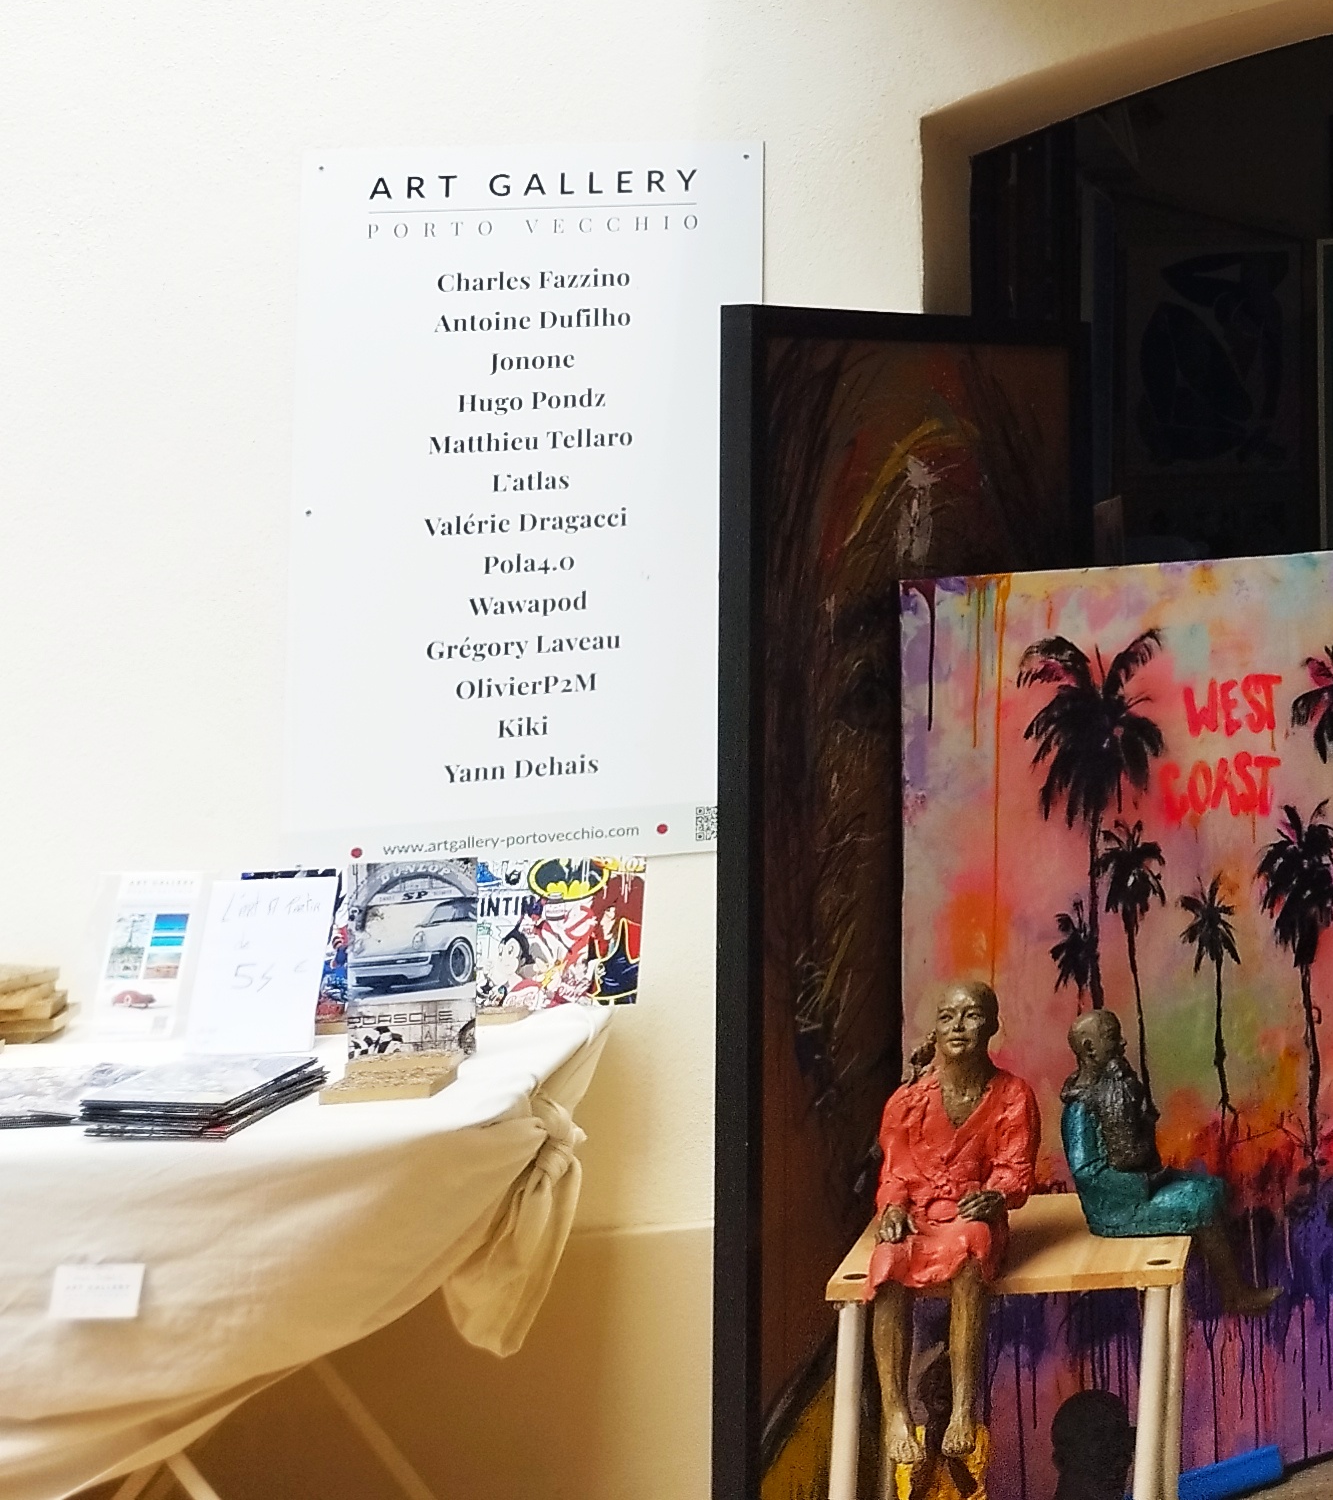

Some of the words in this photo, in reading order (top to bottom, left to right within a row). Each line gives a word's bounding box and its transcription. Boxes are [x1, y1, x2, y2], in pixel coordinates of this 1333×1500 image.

[369, 174, 458, 200] ART
[489, 169, 697, 197] GALLERY
[367, 221, 493, 240] PORTO
[525, 214, 699, 234] VECCHIO
[437, 271, 531, 293] Charles
[539, 267, 630, 289] Fazzino
[434, 311, 531, 333] Antoine
[540, 307, 631, 330] Dufilho
[490, 352, 575, 376] Jonone
[458, 393, 523, 416] Hugo
[531, 387, 606, 410] Pondz
[429, 432, 539, 455] Matthieu
[546, 428, 633, 450] Tellaro
[492, 470, 570, 493] L'atlas
[424, 513, 511, 537] Valérie
[519, 506, 628, 534] Dragacci
[483, 553, 575, 575] Pola4.0
[469, 590, 588, 617] Wawapod
[426, 636, 529, 662] Grégory
[536, 634, 621, 654] Laveau
[455, 672, 597, 700] OlivierP2M
[1184, 673, 1282, 737] WEST
[498, 715, 549, 739] Kiki
[444, 764, 506, 784] Yann
[515, 754, 599, 779] Dehais
[1160, 751, 1281, 823] COAST
[382, 826, 640, 855] www.artgallery-portovecchio.com
[380, 863, 452, 885] DUNLOP
[402, 890, 428, 901] SP
[348, 1010, 453, 1026] PORSCHE
